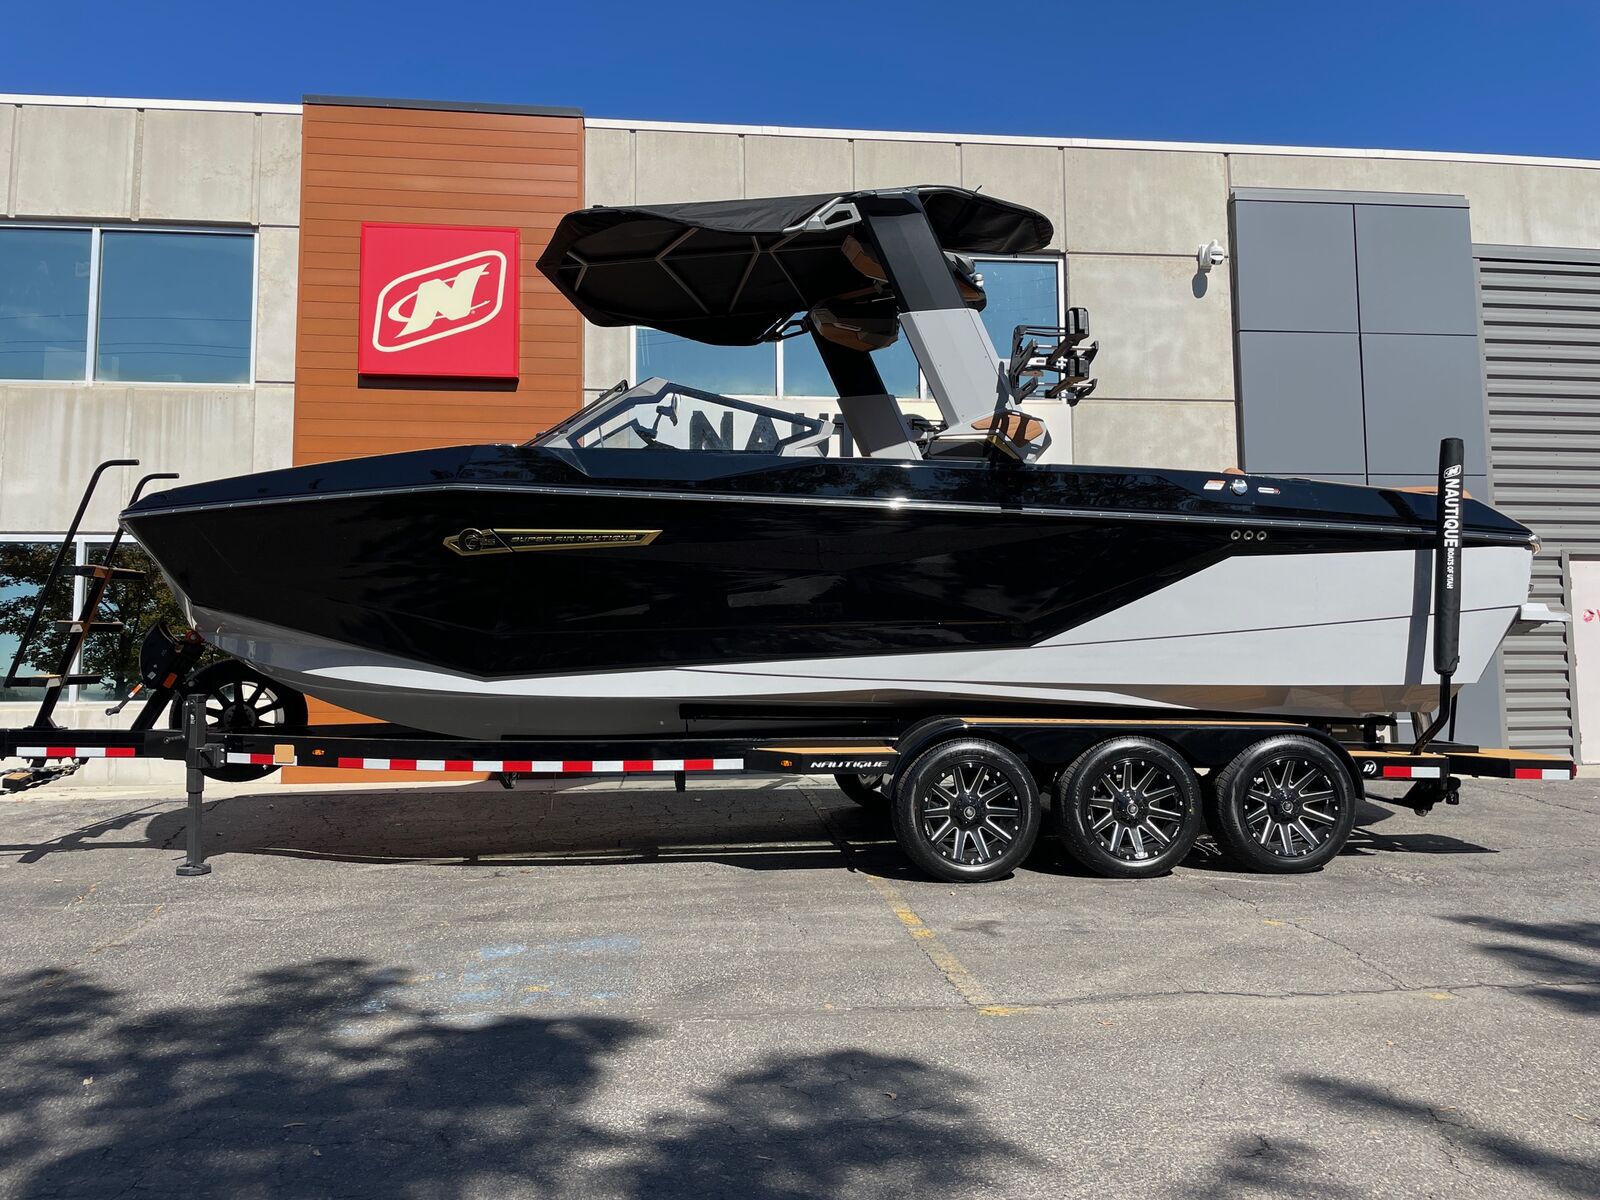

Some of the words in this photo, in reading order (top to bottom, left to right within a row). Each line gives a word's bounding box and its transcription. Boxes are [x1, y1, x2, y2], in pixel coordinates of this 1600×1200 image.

[1444, 479, 1459, 547] NAUTIQUE
[1447, 548, 1455, 565] BOATS
[1447, 566, 1455, 574] OF
[1446, 574, 1454, 589] UTAH
